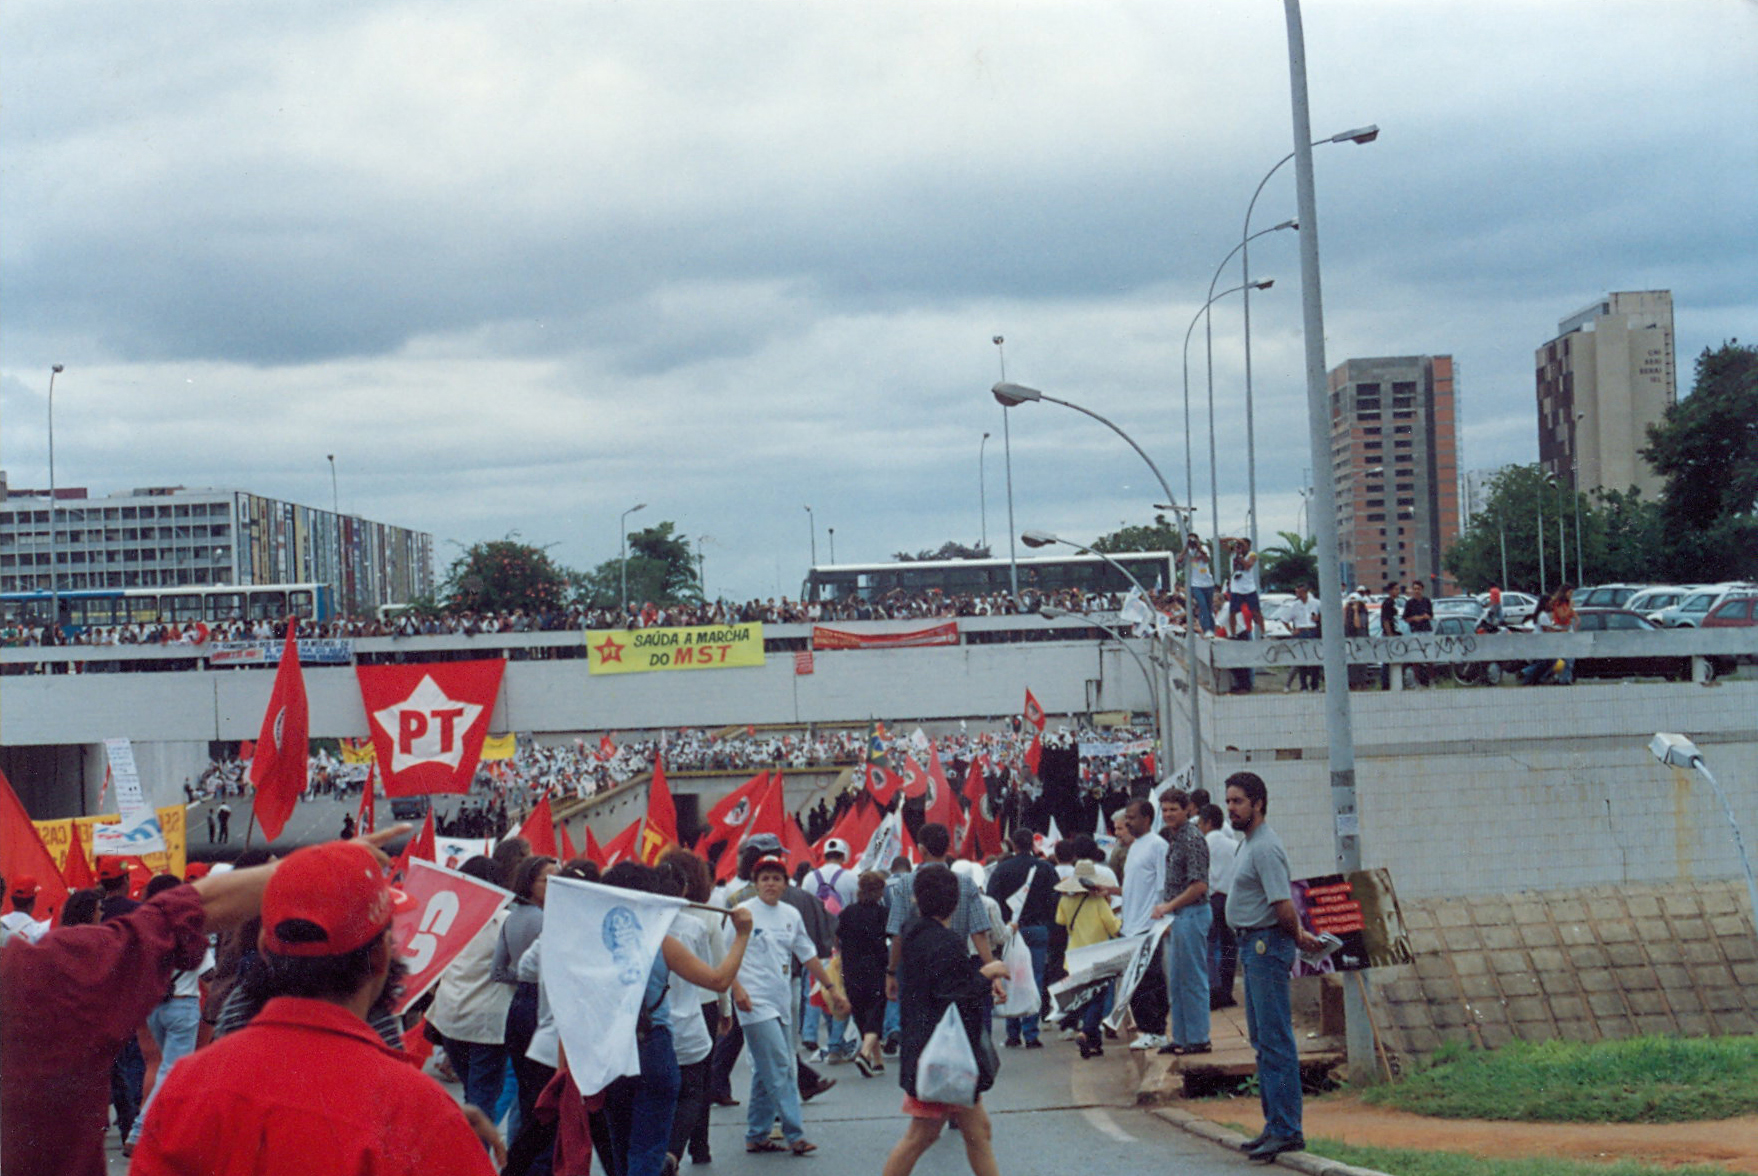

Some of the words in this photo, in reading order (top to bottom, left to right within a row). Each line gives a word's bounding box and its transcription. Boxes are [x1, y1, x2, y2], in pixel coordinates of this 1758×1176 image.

[634, 631, 678, 647] SAÚDA
[683, 632, 692, 645] A
[696, 628, 750, 645] MARCHA
[649, 652, 670, 666] DO
[673, 645, 732, 665] MST
[399, 707, 464, 755] PT
